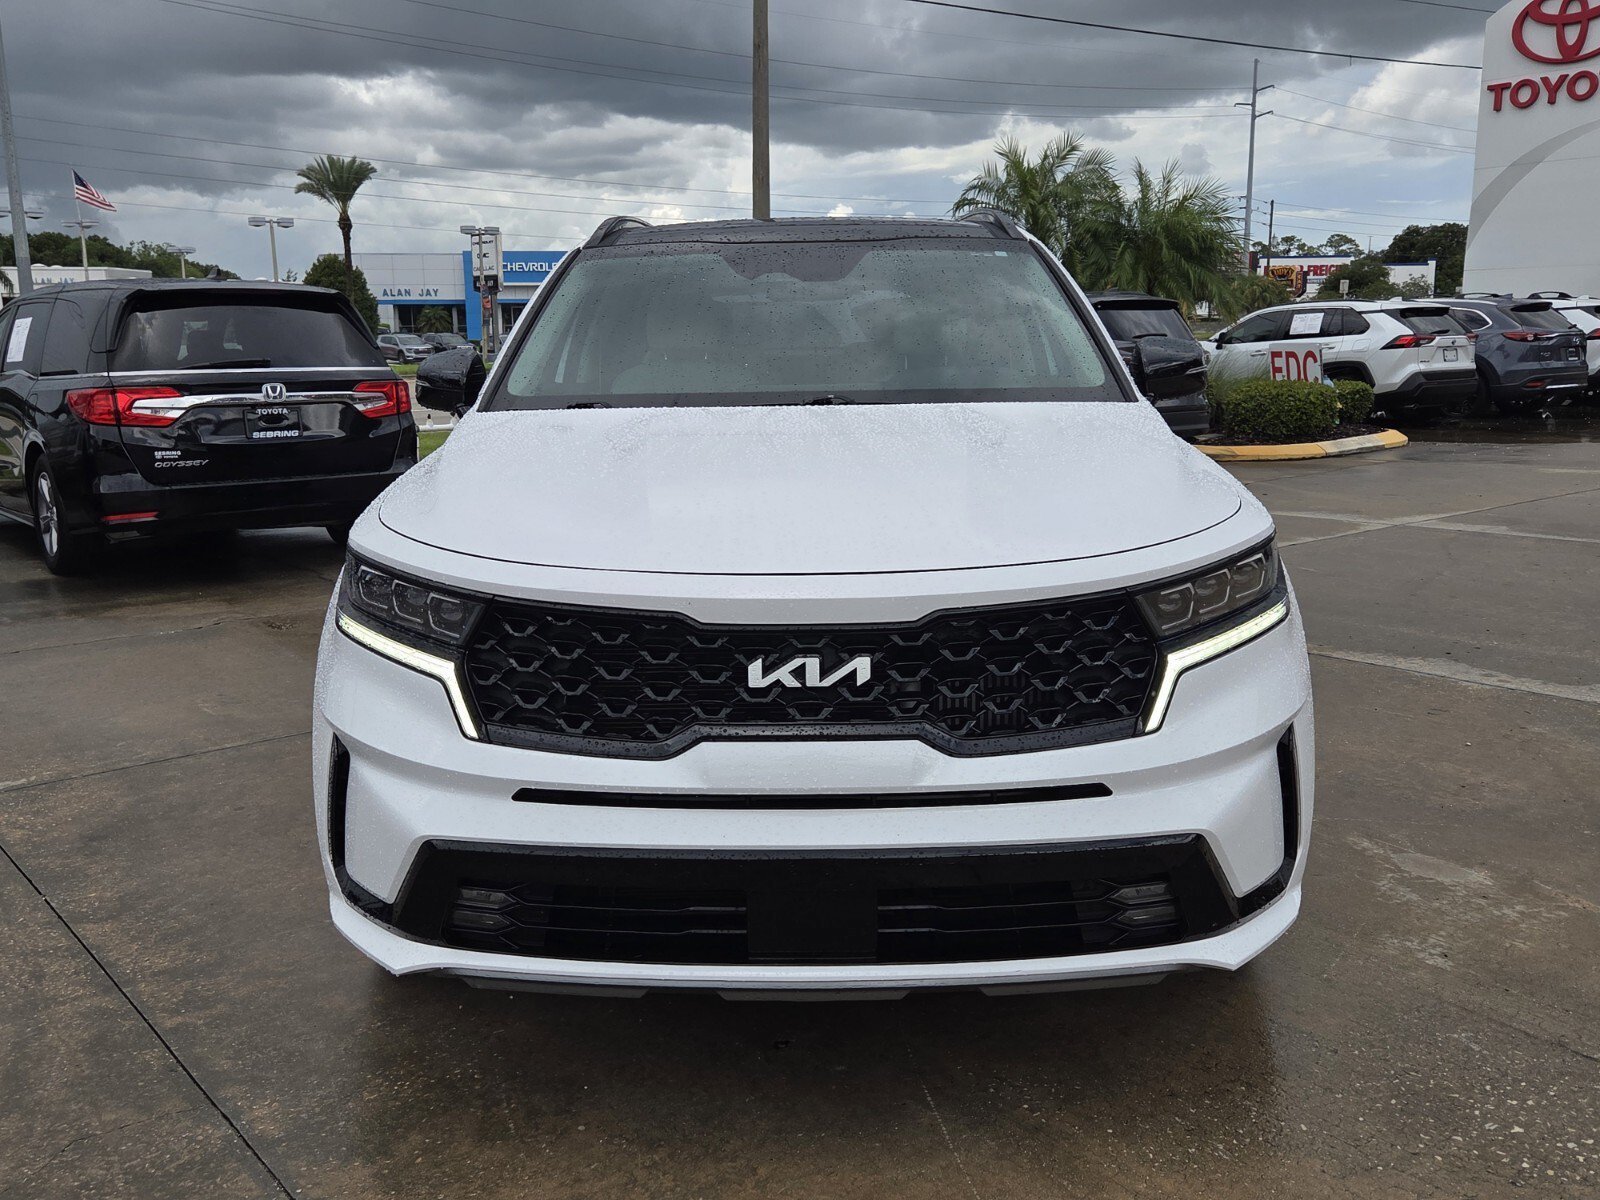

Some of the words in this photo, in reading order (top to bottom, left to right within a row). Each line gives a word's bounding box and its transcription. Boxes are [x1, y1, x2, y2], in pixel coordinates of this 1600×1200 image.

[1487, 70, 1600, 112] TOYO
[502, 262, 557, 272] CHEVROL
[382, 288, 411, 297] ALAN
[418, 288, 439, 297] JAY
[252, 430, 299, 438] SEBRING
[154, 459, 209, 468] ODYSSEY
[748, 656, 871, 688] KIA
